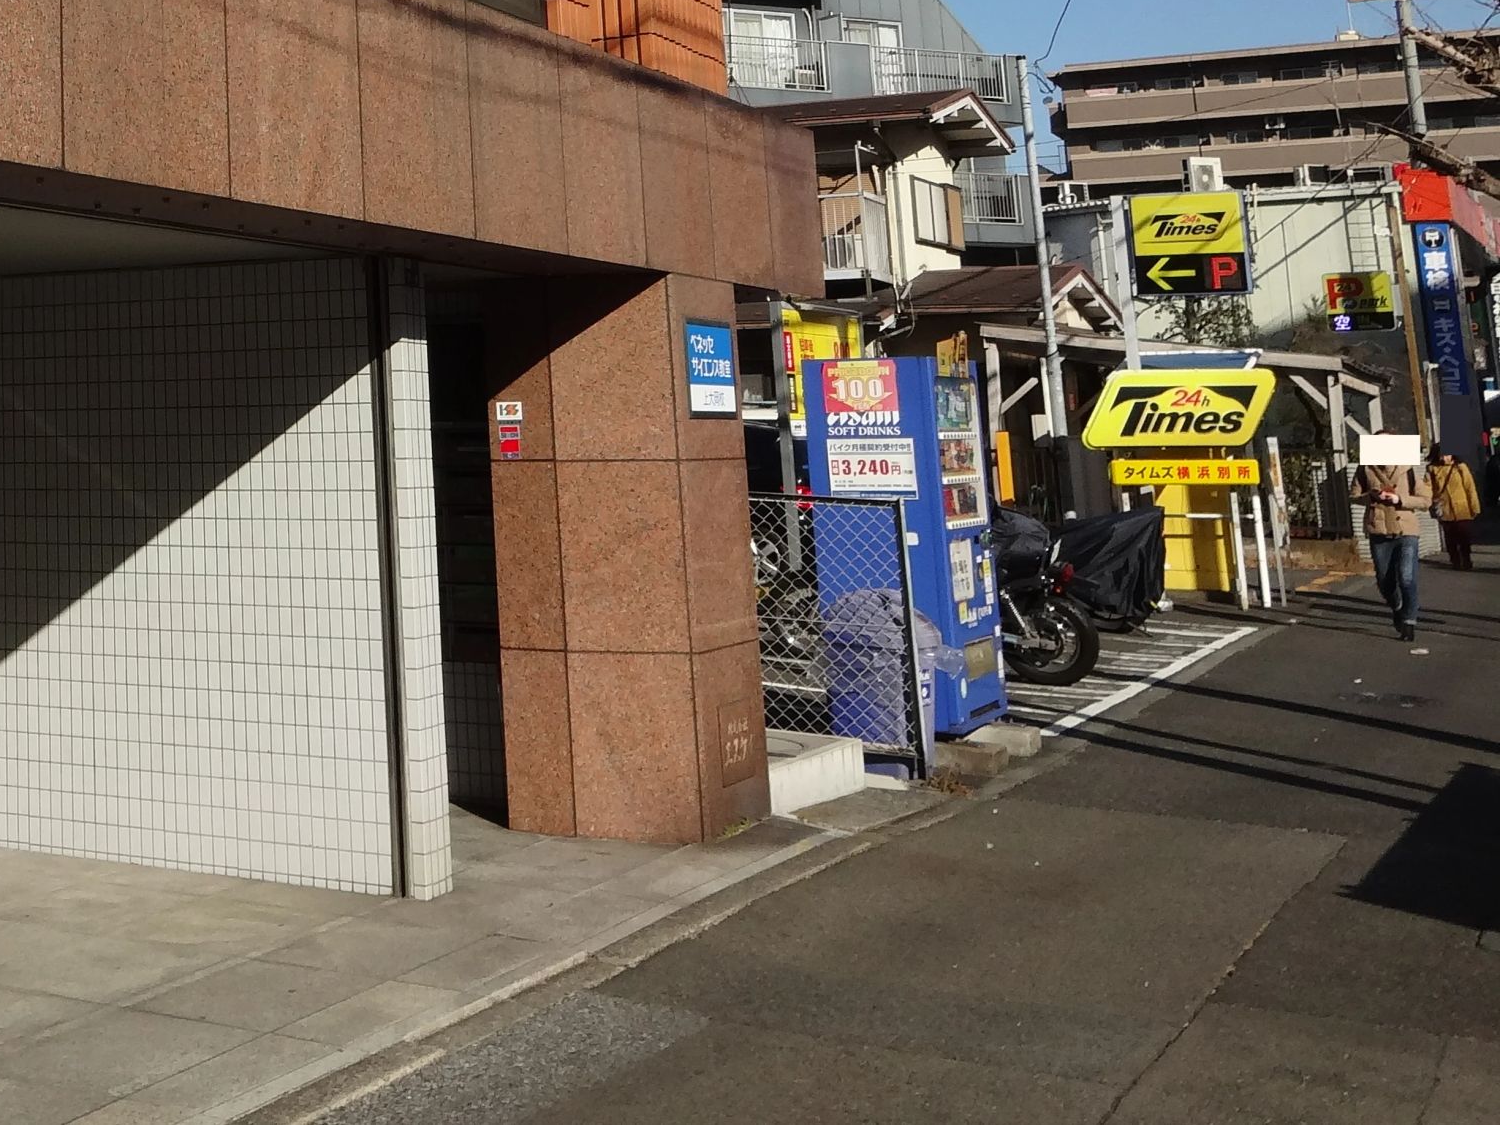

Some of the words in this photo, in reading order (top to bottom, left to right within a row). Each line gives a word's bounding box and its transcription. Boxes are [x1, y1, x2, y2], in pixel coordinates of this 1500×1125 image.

[1153, 218, 1221, 239] Times
[1209, 256, 1239, 290] P
[1333, 314, 1352, 331] 空
[690, 333, 715, 355] ベネッセ
[832, 378, 885, 401] 100
[1170, 389, 1210, 408] 24h
[1117, 396, 1246, 437] Times
[828, 426, 856, 436] SOFT
[858, 426, 901, 436] DRINKS
